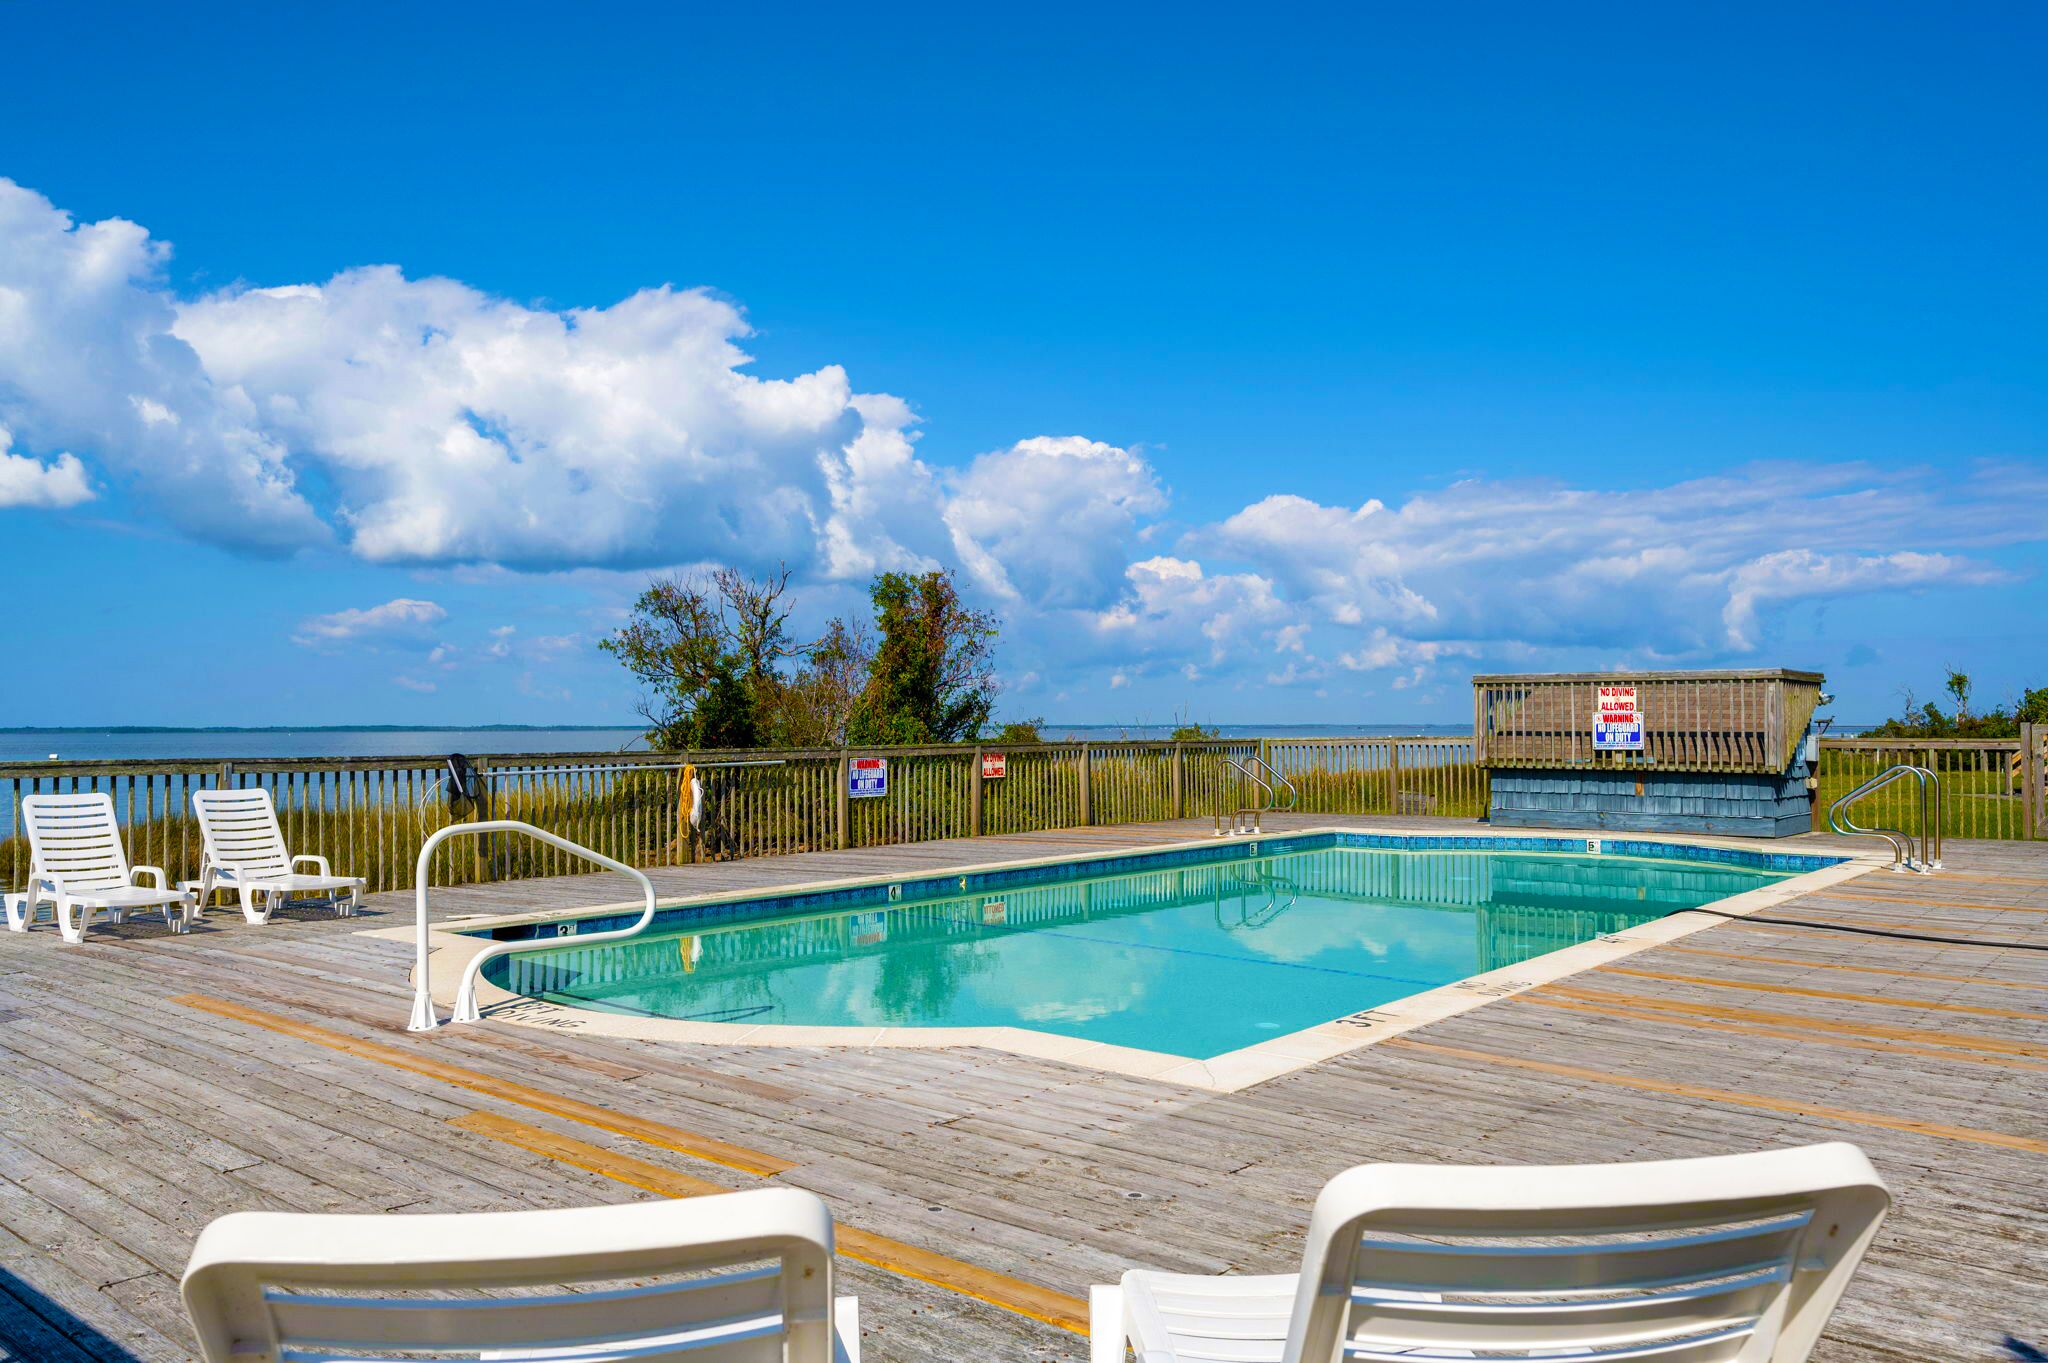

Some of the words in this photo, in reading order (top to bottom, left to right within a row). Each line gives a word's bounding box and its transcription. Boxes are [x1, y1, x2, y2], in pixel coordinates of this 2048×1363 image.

[1600, 687, 1610, 697] NO
[1611, 687, 1635, 697] DIVING
[1601, 702, 1635, 711] ALLOWED
[1602, 714, 1634, 723] WARNING
[1597, 723, 1606, 733] NO
[1606, 723, 1639, 733] LIFEGUARD
[1605, 732, 1614, 742] ON
[1615, 732, 1632, 742] DUTY
[856, 759, 880, 770] WARNING
[983, 767, 1005, 777] ALLOWED
